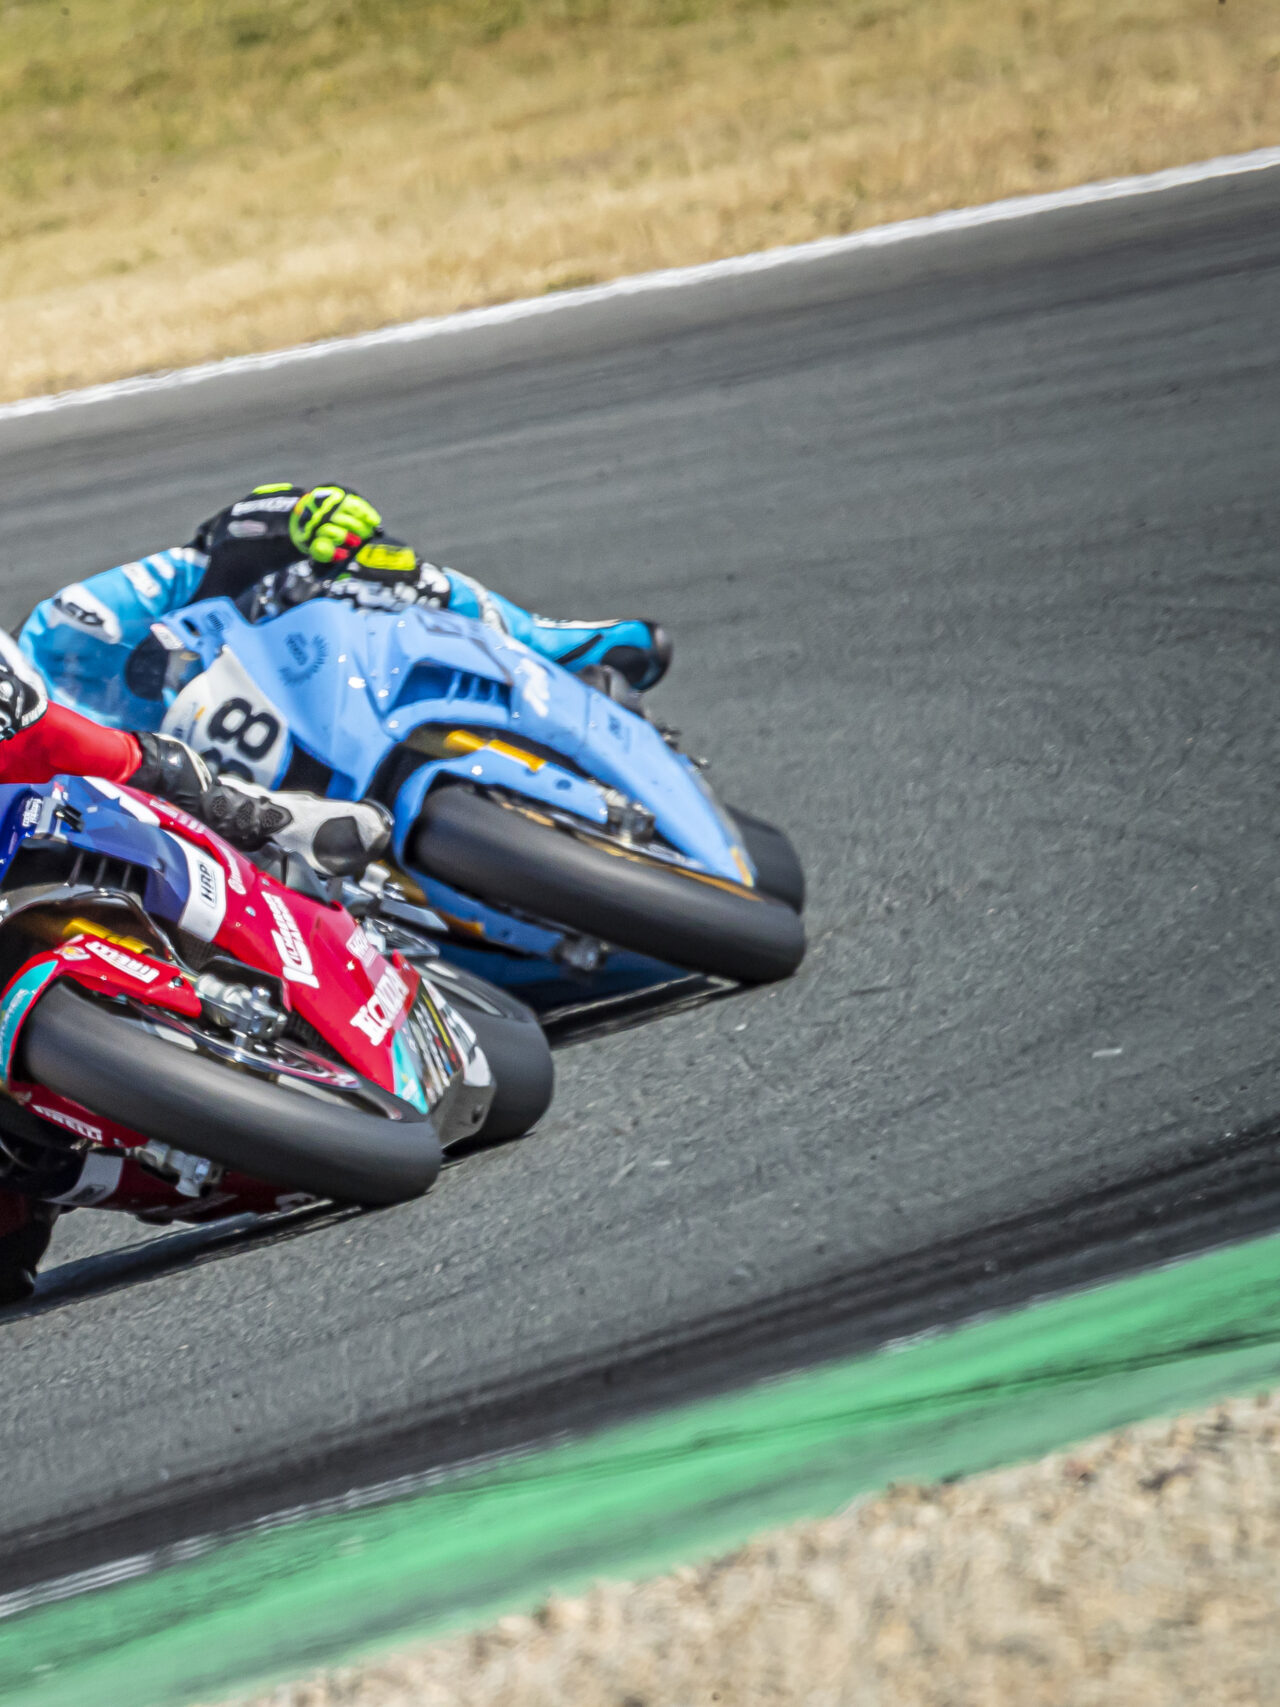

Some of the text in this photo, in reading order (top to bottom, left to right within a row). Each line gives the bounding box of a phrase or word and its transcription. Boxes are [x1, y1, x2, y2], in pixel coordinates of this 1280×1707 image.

[200, 865, 212, 901] HRP
[86, 940, 158, 984] PIRELLI
[350, 966, 410, 1046] HONDA
